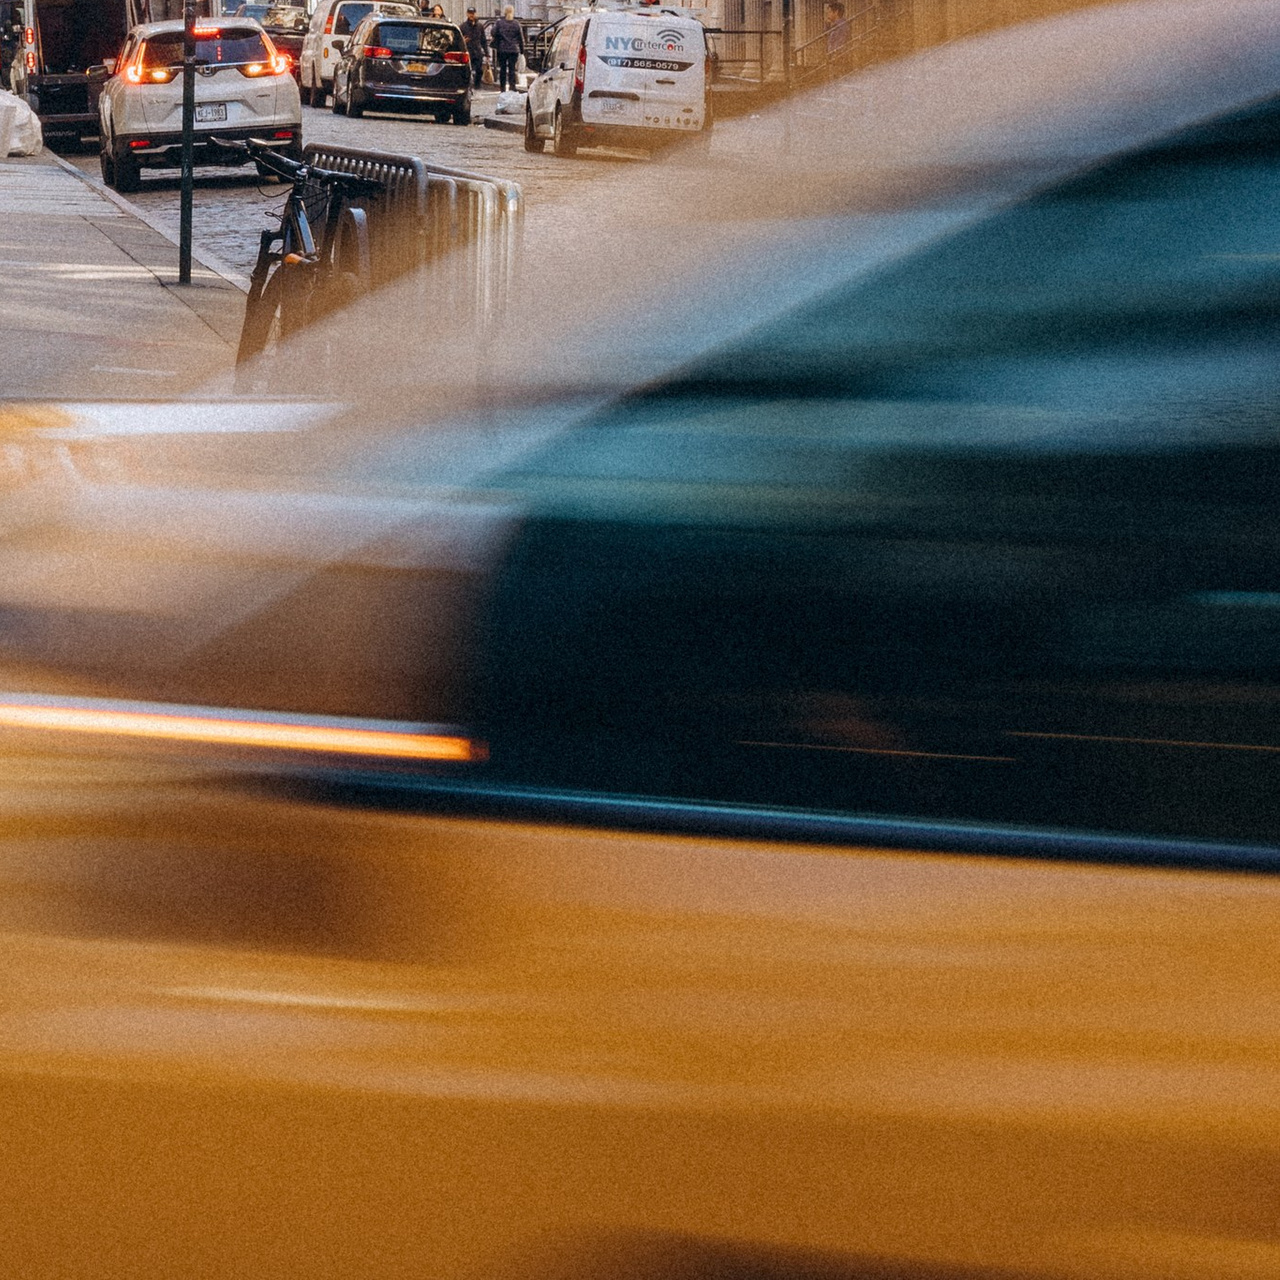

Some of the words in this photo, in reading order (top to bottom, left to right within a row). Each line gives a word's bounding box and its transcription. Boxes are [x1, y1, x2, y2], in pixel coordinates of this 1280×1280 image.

[605, 37, 644, 52] NYC
[636, 40, 684, 52] intercom
[608, 58, 631, 67] (917)
[633, 60, 679, 70] 565-0579
